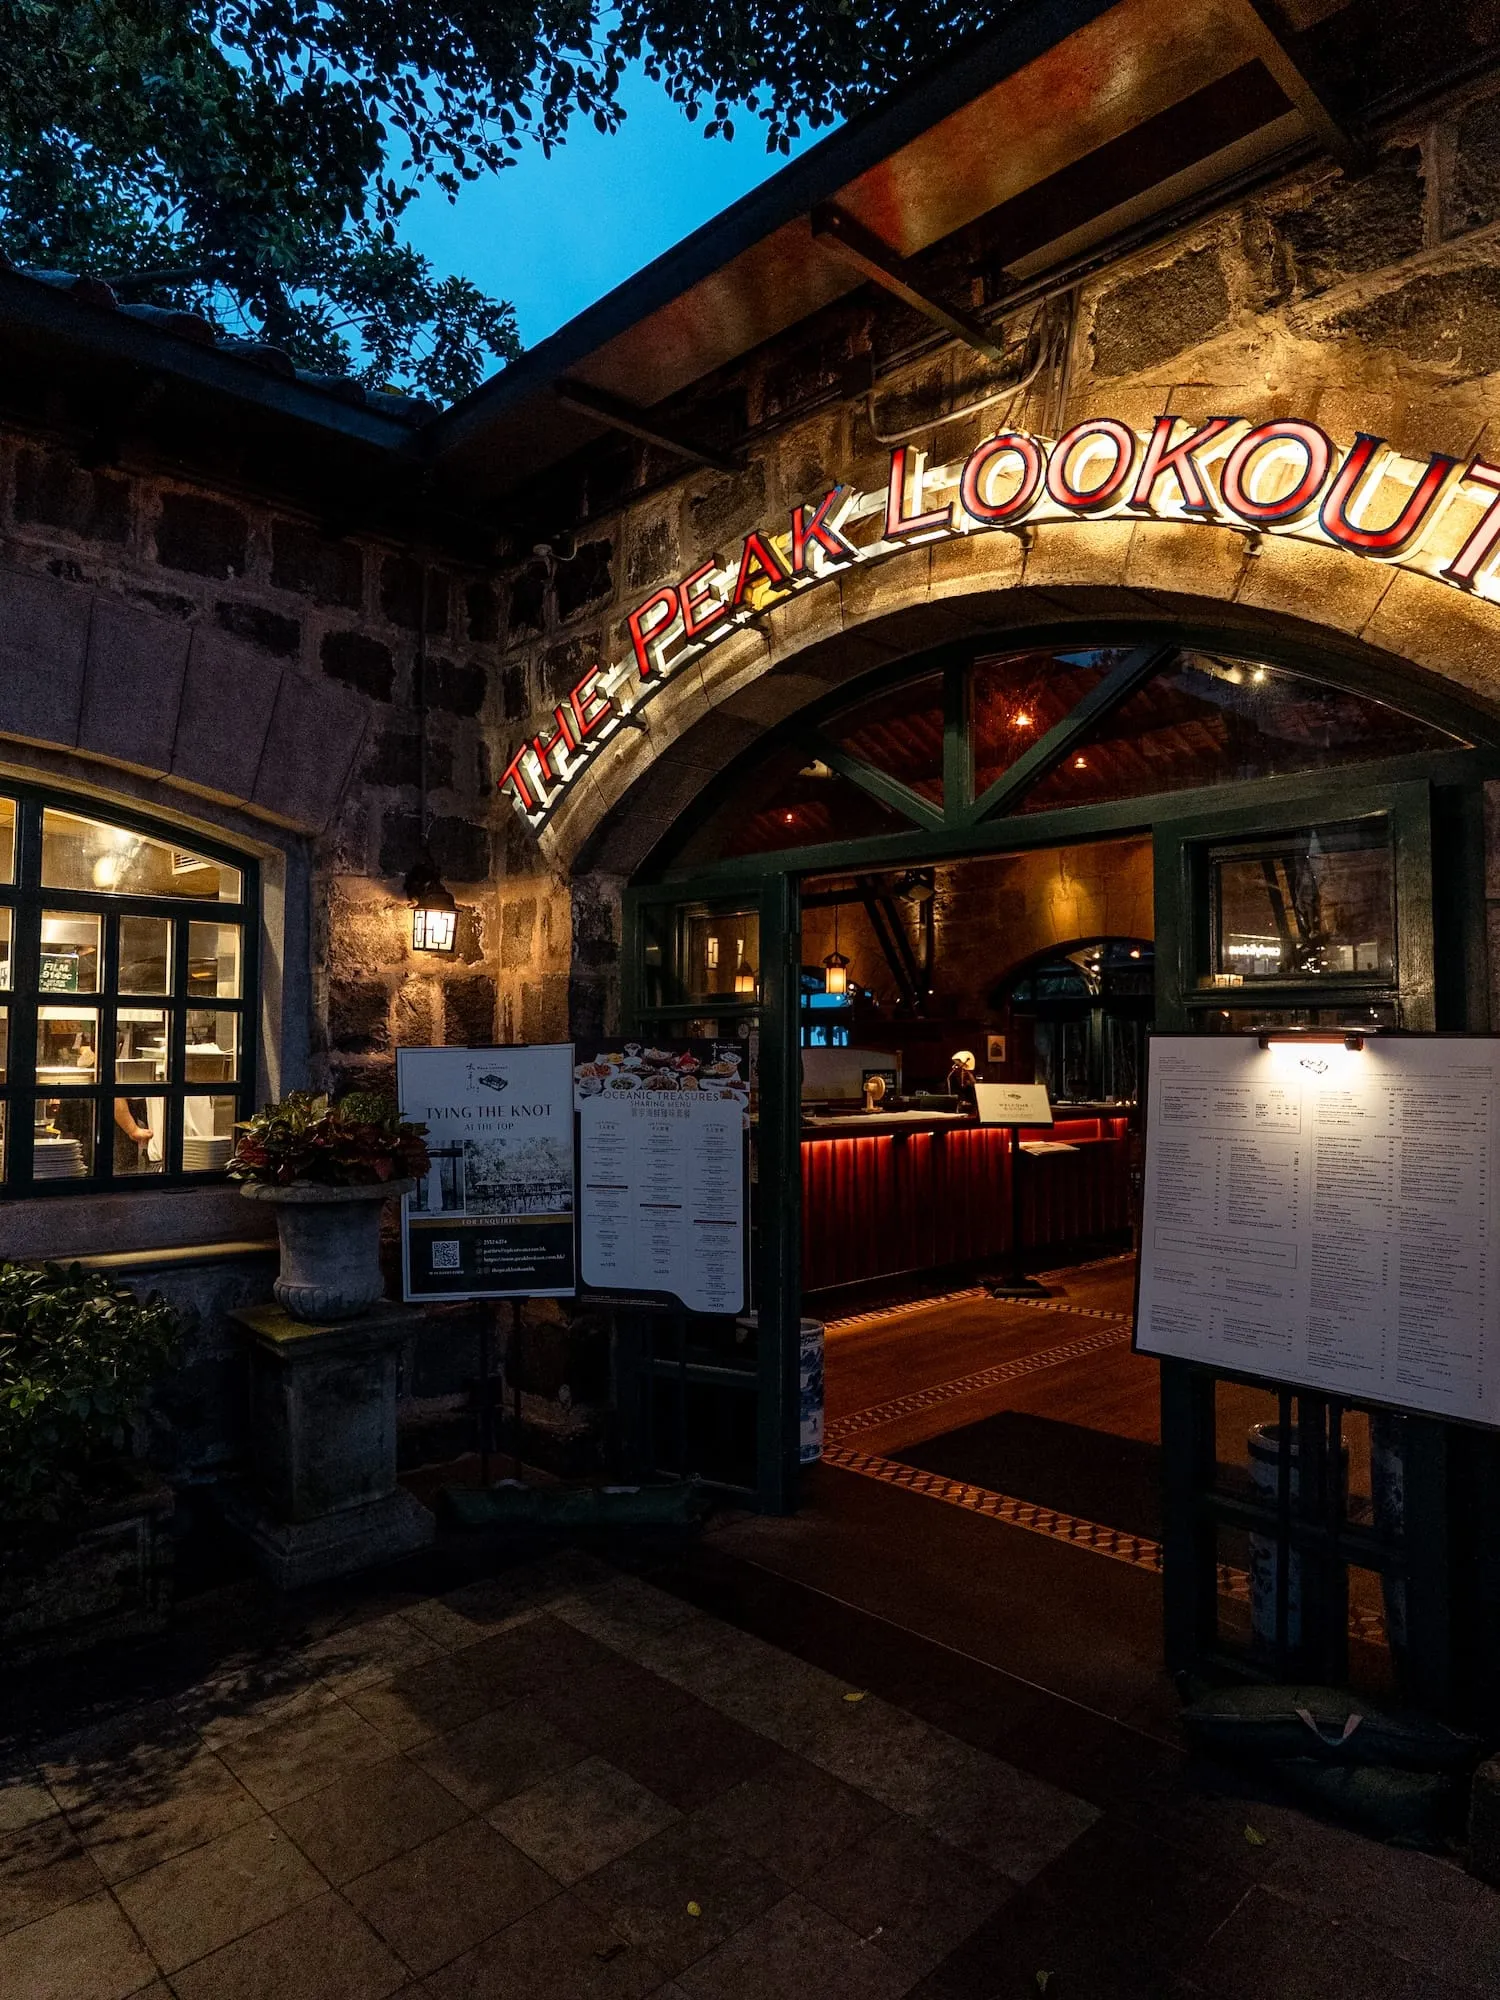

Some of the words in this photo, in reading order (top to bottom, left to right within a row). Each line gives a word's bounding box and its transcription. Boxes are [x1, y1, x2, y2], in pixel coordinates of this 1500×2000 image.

[497, 663, 622, 816] THE
[626, 484, 850, 684] PEAK
[883, 415, 1500, 589] LOOKOUT
[603, 1089, 653, 1100] OCEANIC
[657, 1090, 719, 1102] TREASURES
[630, 1100, 665, 1108] SHARING
[425, 1106, 472, 1120] TYING
[478, 1105, 506, 1118] THE
[511, 1103, 553, 1117] KNOT
[464, 1123, 474, 1131] AT
[476, 1123, 492, 1131] THE
[497, 1122, 514, 1131] TOP
[480, 1217, 521, 1225] ENQUIRIES
